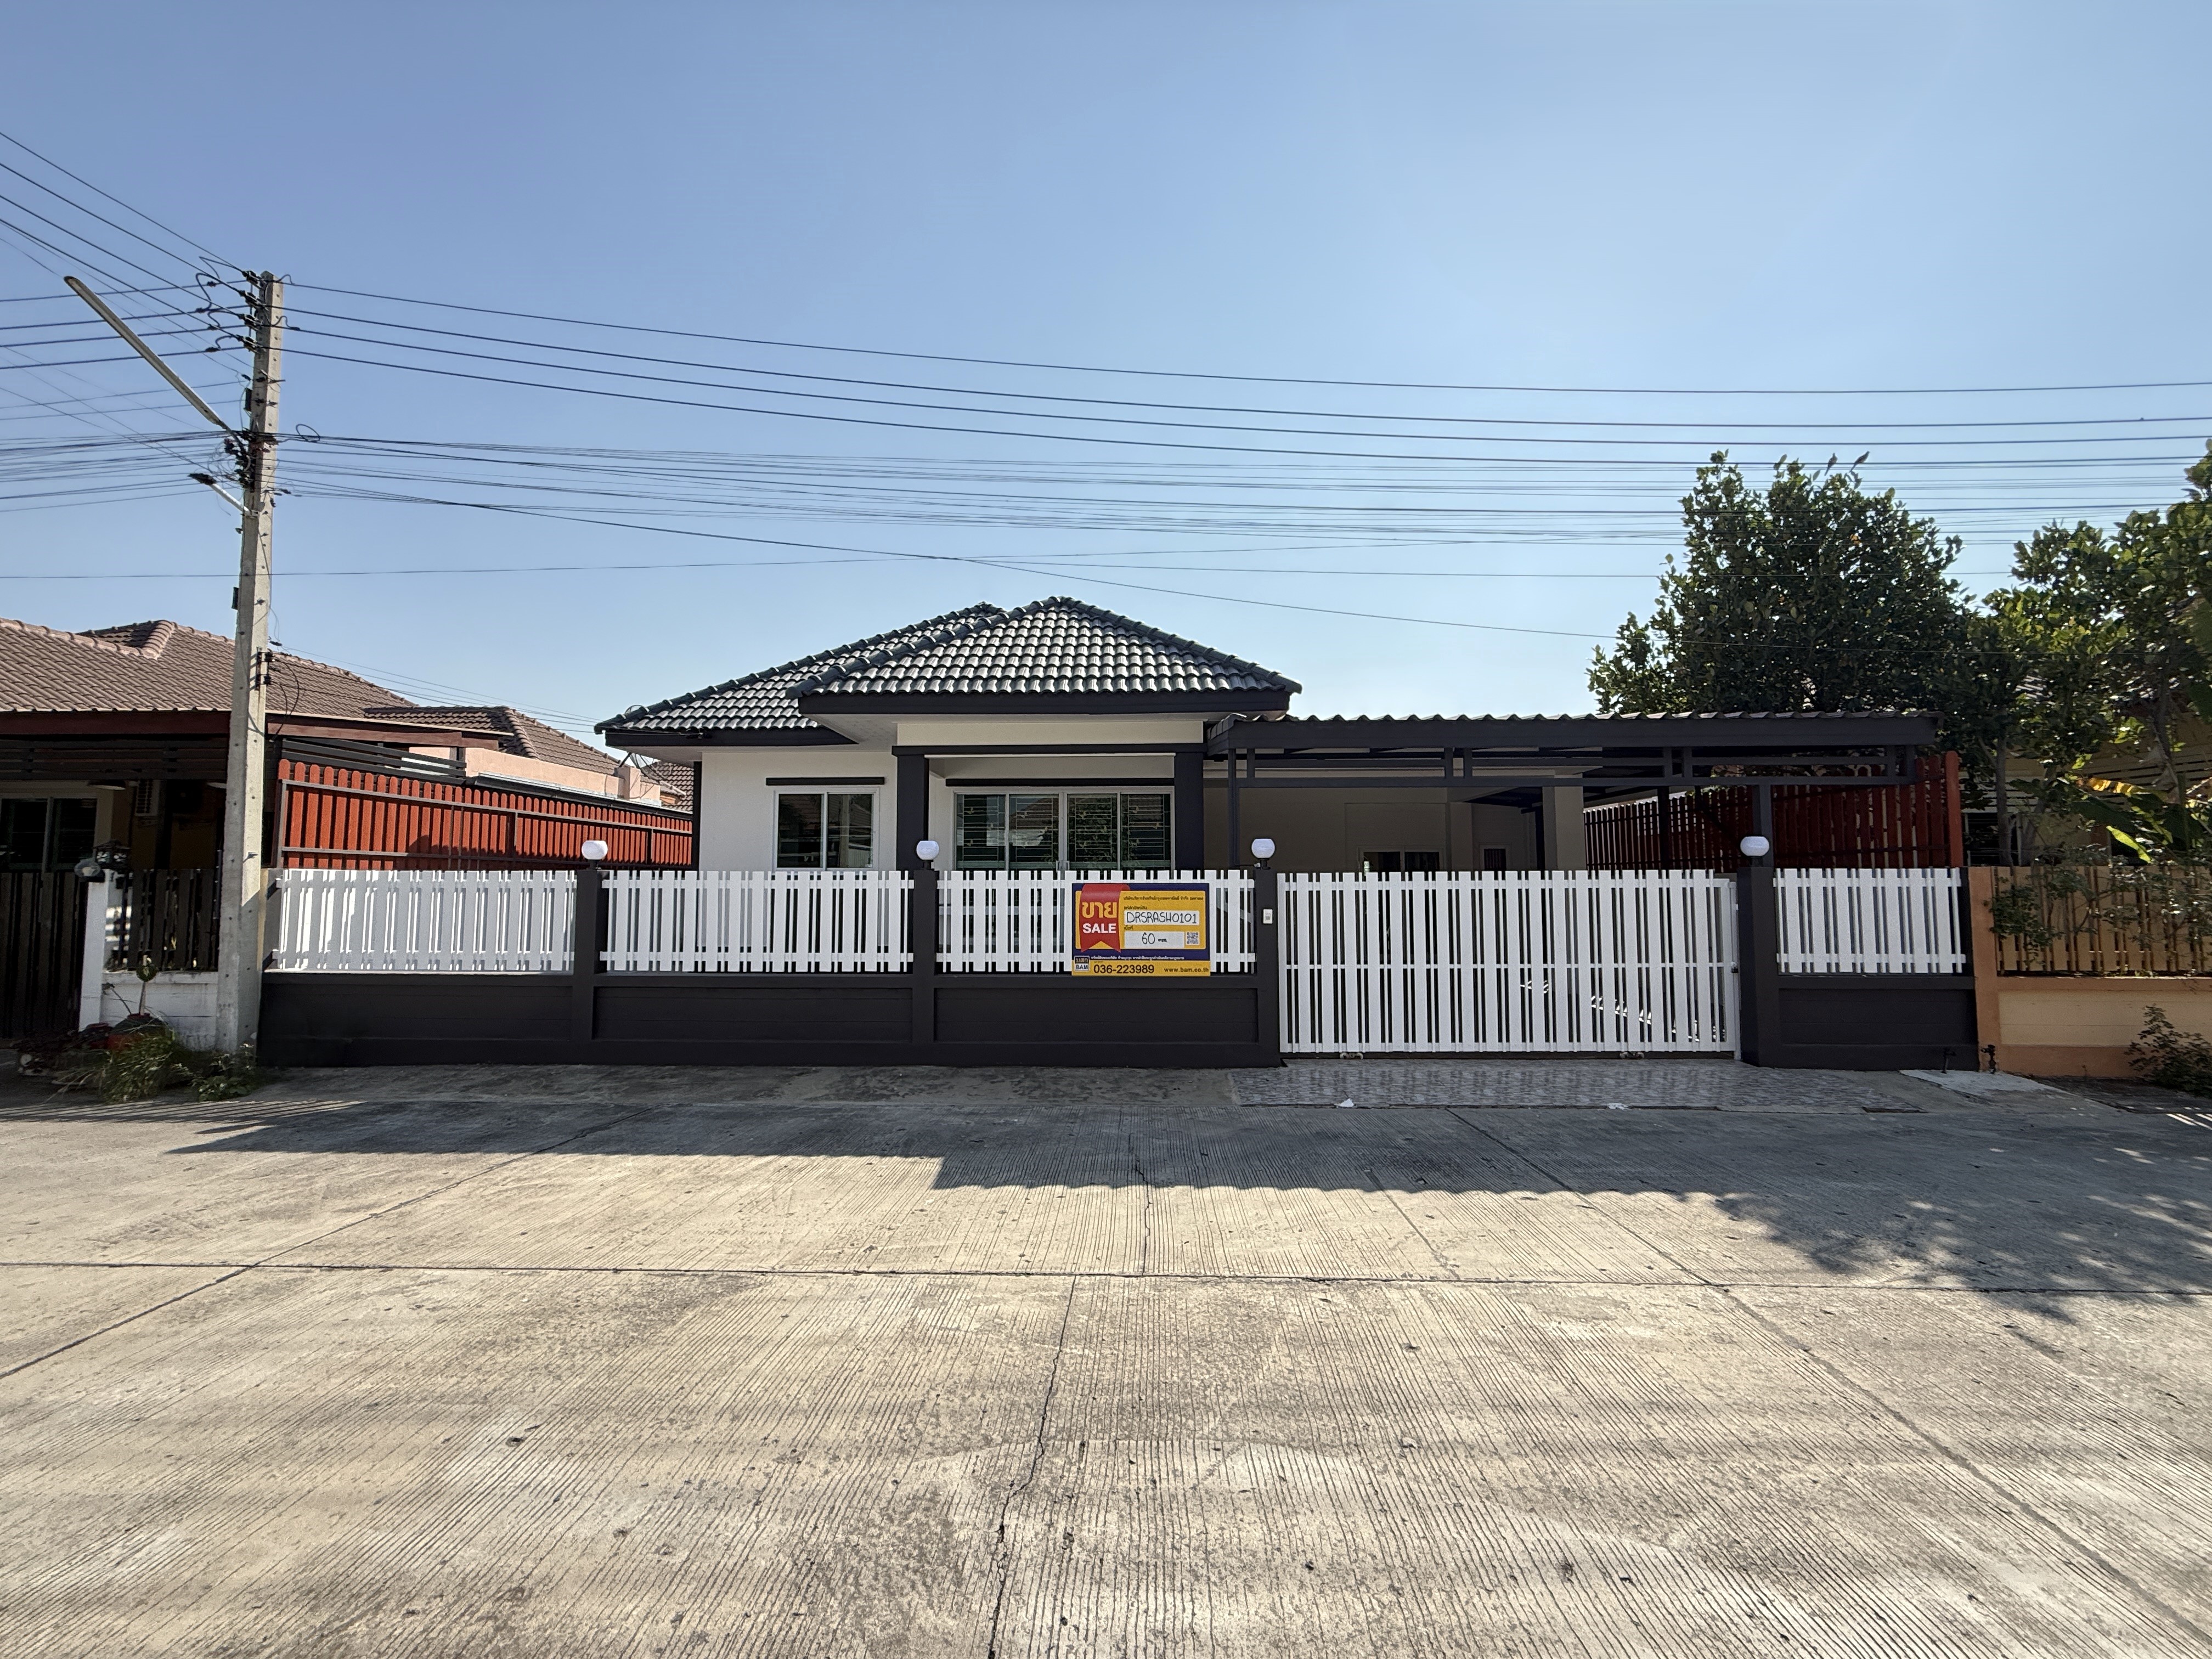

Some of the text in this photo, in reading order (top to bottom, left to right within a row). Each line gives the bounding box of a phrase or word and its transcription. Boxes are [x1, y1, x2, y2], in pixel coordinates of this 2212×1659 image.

[1082, 902, 1117, 918] ขาย
[1082, 923, 1116, 934] SALE
[1142, 932, 1155, 944] 60
[1093, 964, 1155, 974] 036-223989
